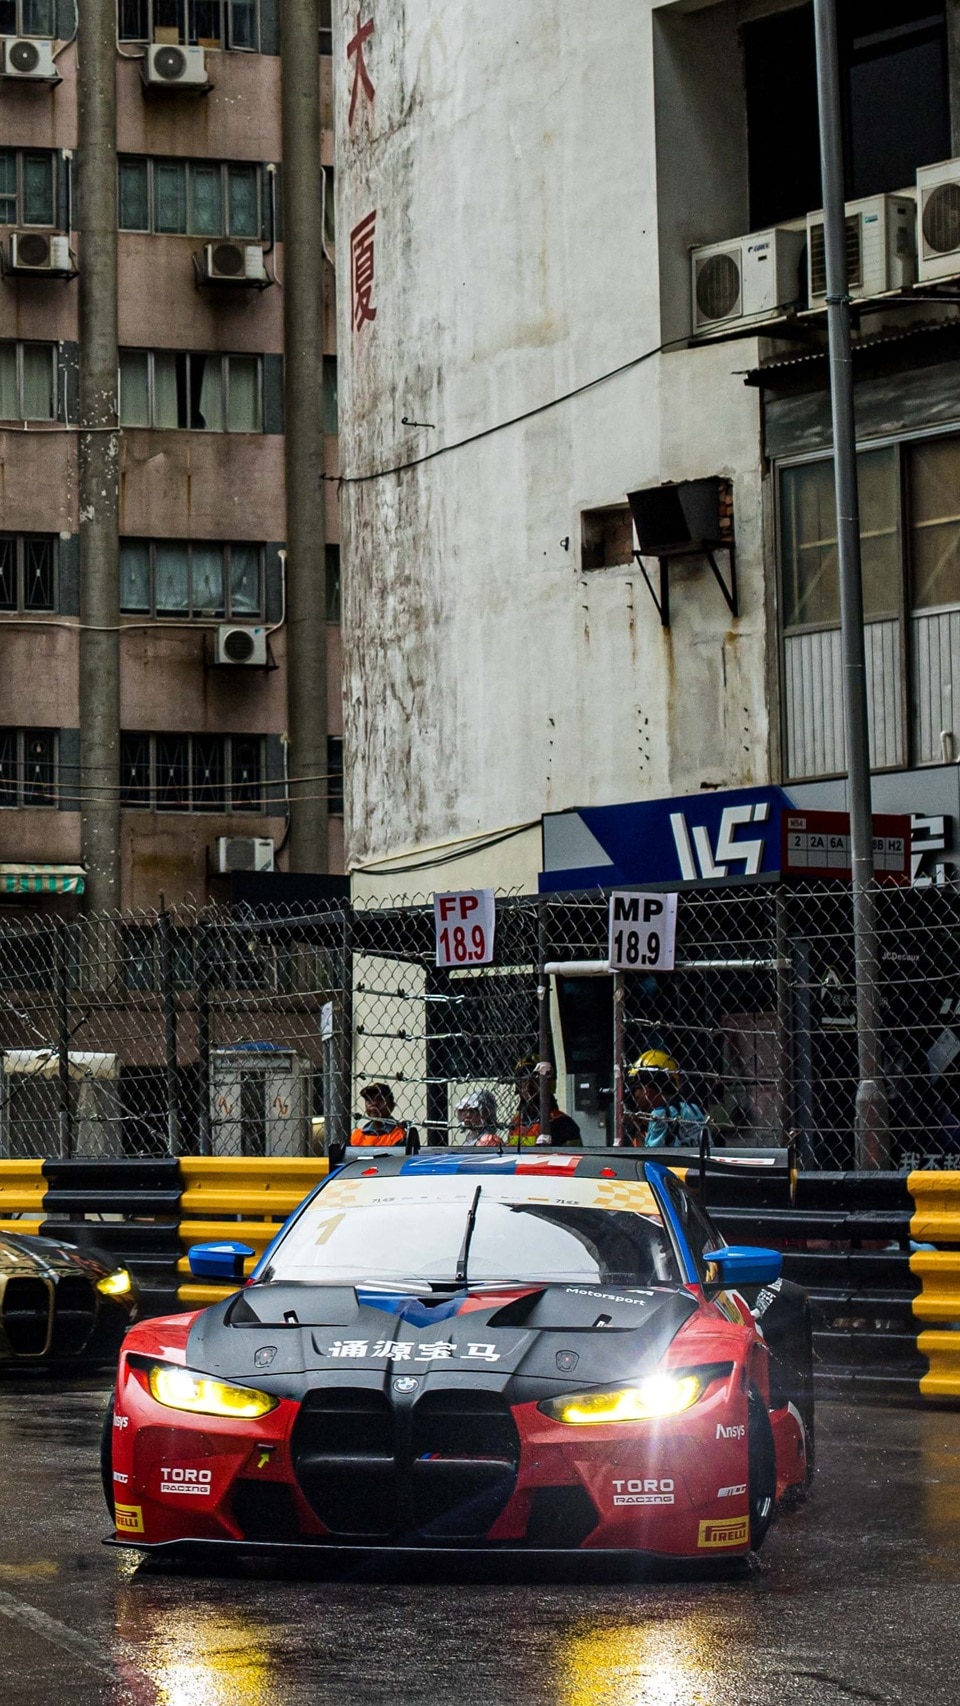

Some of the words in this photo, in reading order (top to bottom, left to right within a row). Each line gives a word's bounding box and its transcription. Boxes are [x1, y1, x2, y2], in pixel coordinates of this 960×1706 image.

[794, 836, 801, 847] 2
[811, 836, 825, 848] 2A
[830, 837, 844, 848] 6A
[888, 839, 902, 851] H2
[439, 896, 479, 921] FP
[614, 898, 664, 922] MP
[440, 925, 486, 962] 18.9
[614, 930, 661, 965] 18.9
[315, 1213, 346, 1245] 1
[565, 1287, 646, 1306] Motorsport
[327, 1339, 501, 1362] 通源宝马
[715, 1423, 745, 1441] Ansys
[161, 1467, 212, 1483] TORO
[162, 1484, 208, 1493] RACING
[612, 1478, 675, 1493] TORO
[615, 1495, 673, 1503] RACING
[705, 1522, 747, 1542] PIRELLI
